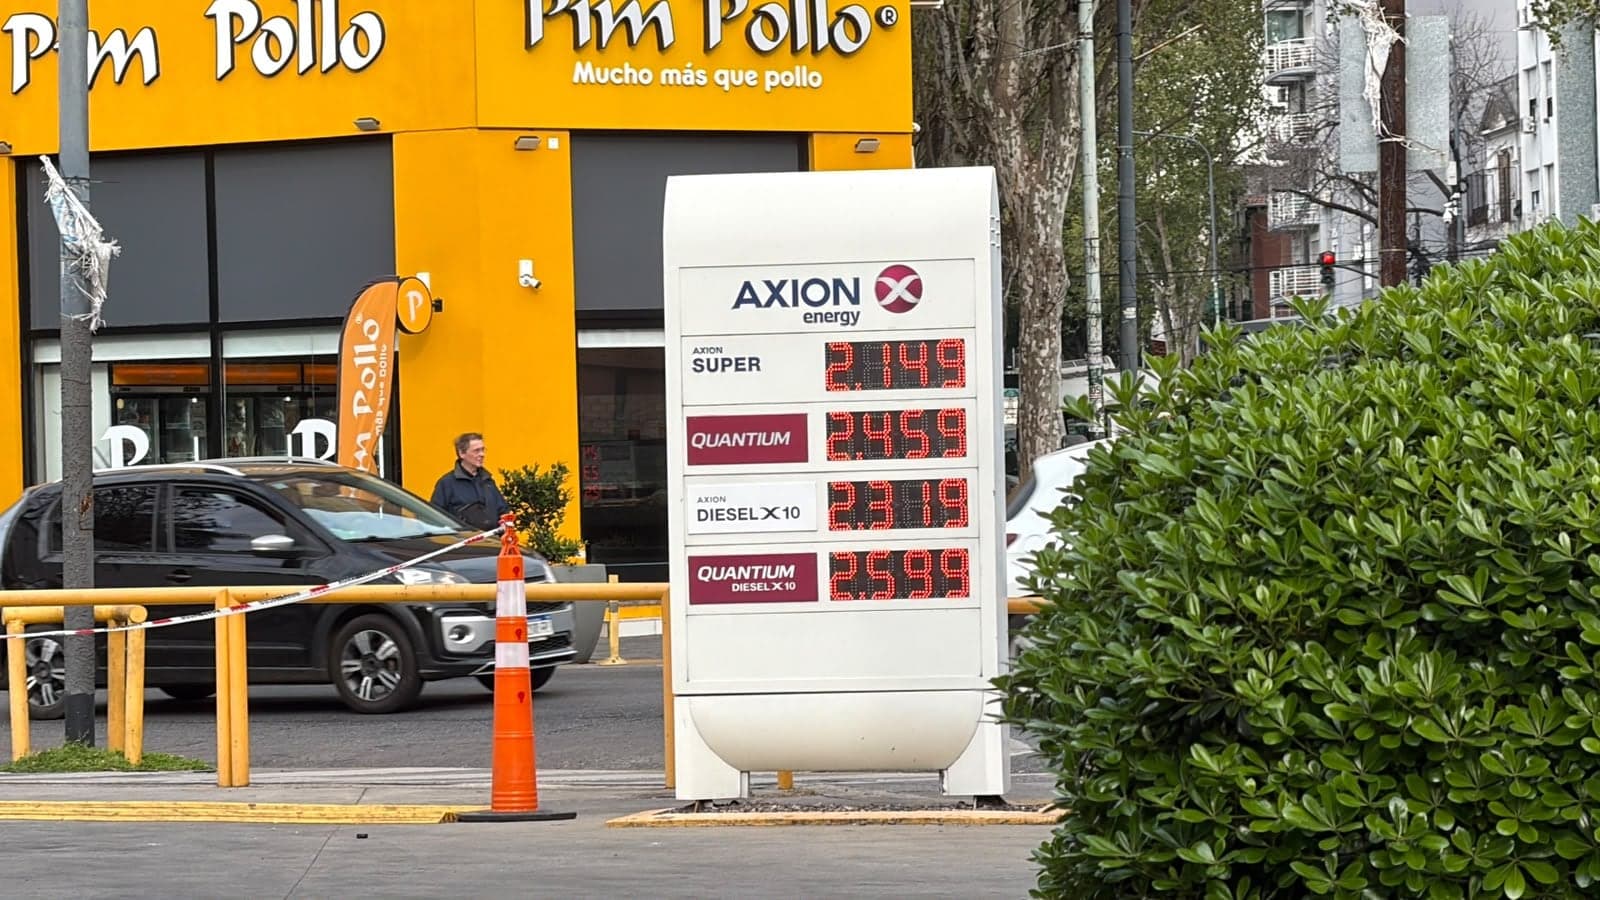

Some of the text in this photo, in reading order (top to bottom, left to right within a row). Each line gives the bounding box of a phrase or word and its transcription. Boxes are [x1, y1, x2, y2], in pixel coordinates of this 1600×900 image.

[1, 0, 386, 95] Pm Pollo
[572, 61, 823, 92] Mucho más que pollo
[406, 290, 424, 323] P
[731, 277, 861, 310] AXION
[802, 310, 861, 327] energy
[691, 357, 761, 373] SUPER
[692, 346, 723, 355] AXION
[825, 338, 966, 392] 2.149
[353, 319, 380, 419] Pollo
[691, 431, 791, 449] QUANTIUM
[826, 408, 967, 461] 2.459
[697, 496, 726, 504] AXION
[828, 478, 969, 531] 2.319
[697, 564, 795, 582] QUANTIUM
[829, 548, 970, 601] 2.599
